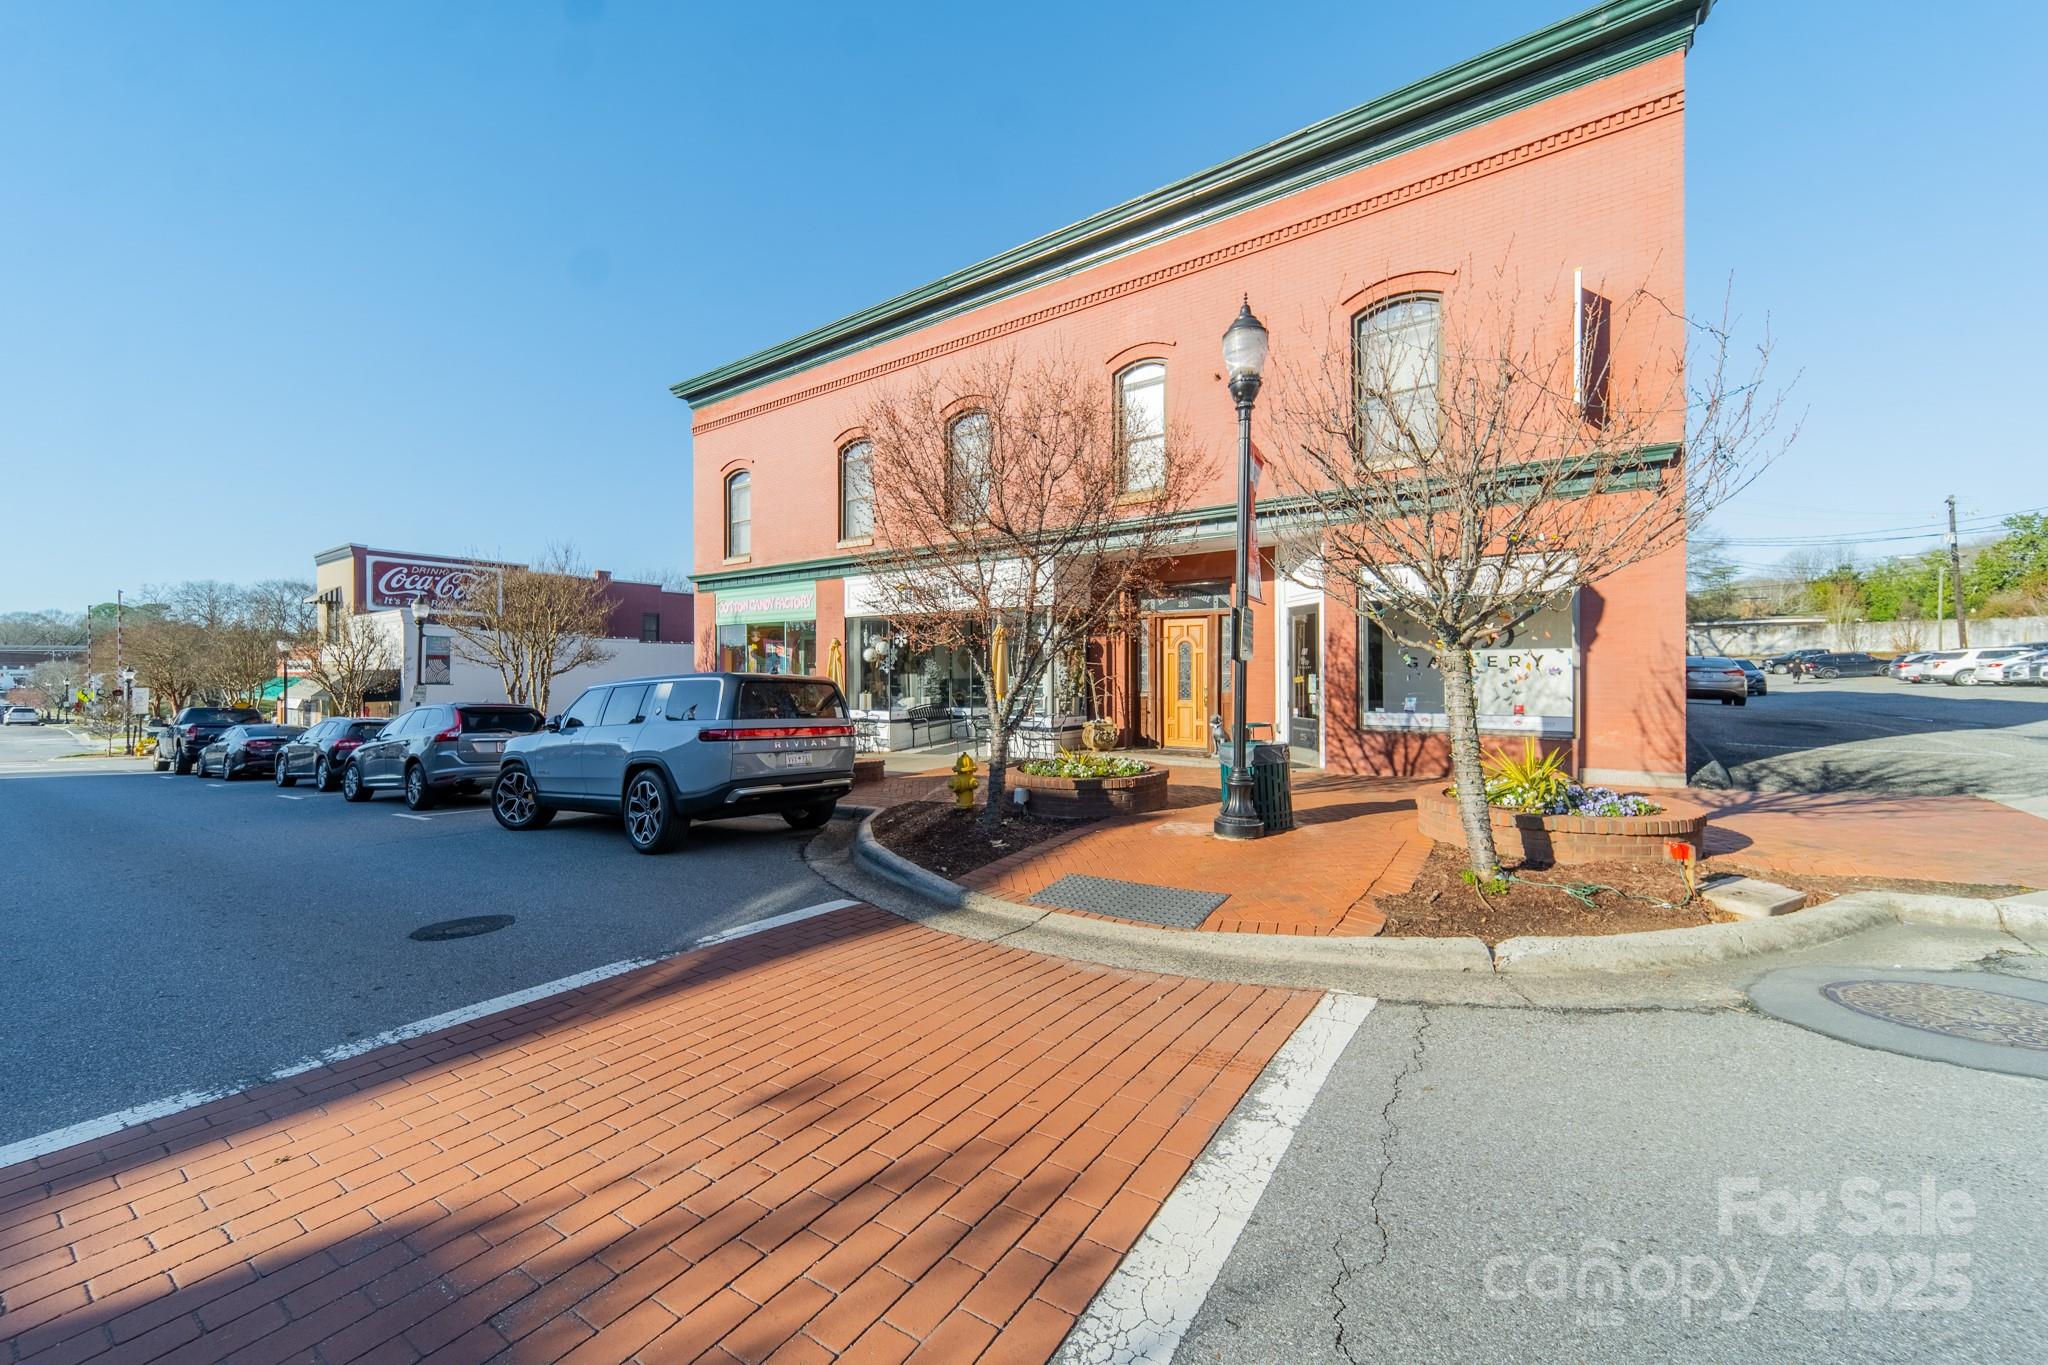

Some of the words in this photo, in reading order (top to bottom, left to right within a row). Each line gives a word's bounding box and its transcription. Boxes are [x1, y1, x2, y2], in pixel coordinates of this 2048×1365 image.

[411, 566, 450, 576] DRINK
[378, 566, 493, 600] Coca-Co
[384, 596, 400, 605] It's
[1406, 653, 1544, 669] GAERY
[774, 739, 828, 749] RIVIAN
